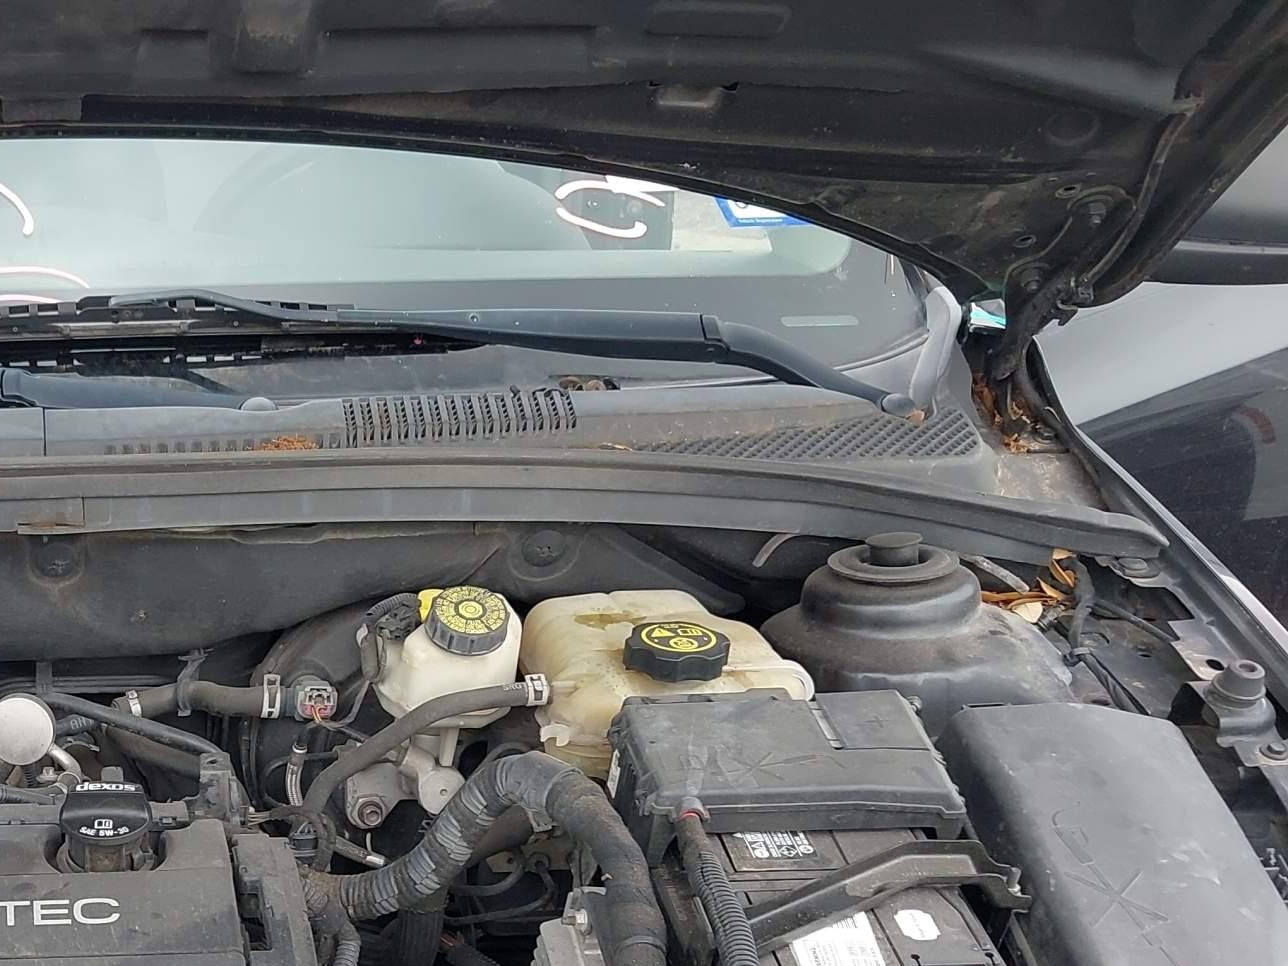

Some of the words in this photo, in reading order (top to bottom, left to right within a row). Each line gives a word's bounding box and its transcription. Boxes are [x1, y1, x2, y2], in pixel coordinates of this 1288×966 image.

[76, 782, 136, 792] dexos
[79, 826, 97, 836] SAE
[99, 827, 130, 837] 5W-30
